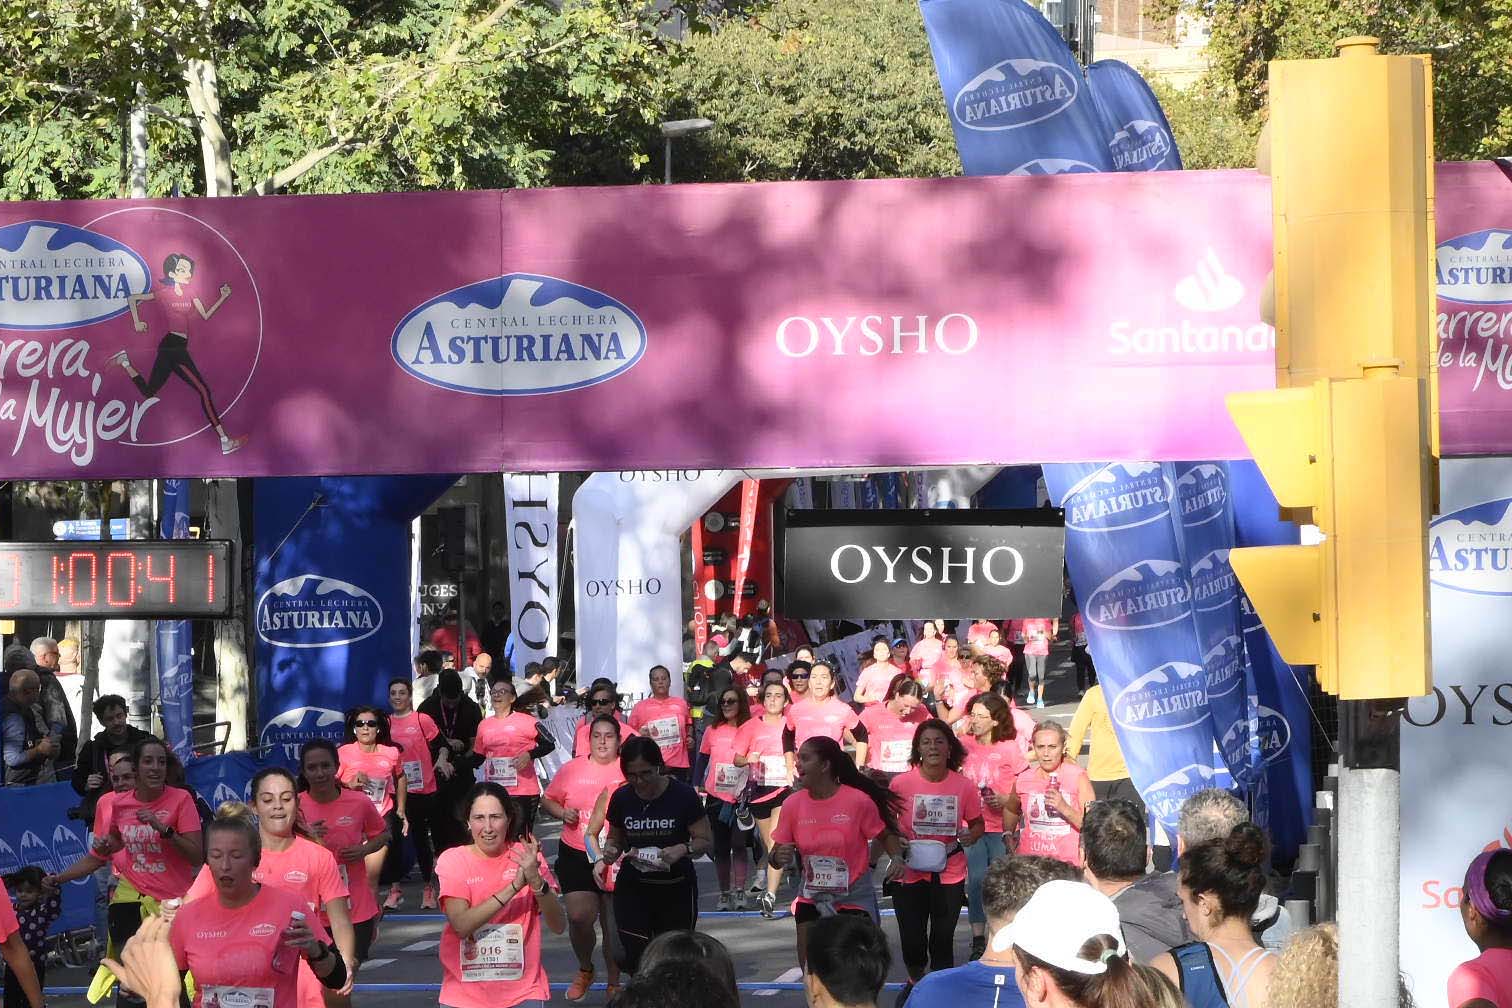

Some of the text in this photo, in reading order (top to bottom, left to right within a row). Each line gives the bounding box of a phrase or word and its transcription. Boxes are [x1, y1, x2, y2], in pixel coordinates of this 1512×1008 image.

[52, 255, 127, 270] LECHERA
[450, 313, 618, 330] CENTRAL LECHERA
[1436, 311, 1512, 340] arrer
[411, 321, 626, 367] ASTURIANA
[775, 313, 979, 358] OYSHO
[1109, 320, 1275, 354] Santand
[1460, 343, 1476, 368] la
[12, 371, 161, 466] Mujer
[1456, 533, 1512, 543] CENTRA
[829, 544, 1025, 586] OYSHO
[585, 577, 662, 598] OYSHO
[273, 599, 369, 609] CENTRAL LECHERA
[261, 605, 374, 632] ASTURIANA
[624, 816, 675, 830] Gartner
[481, 947, 502, 955] 016
